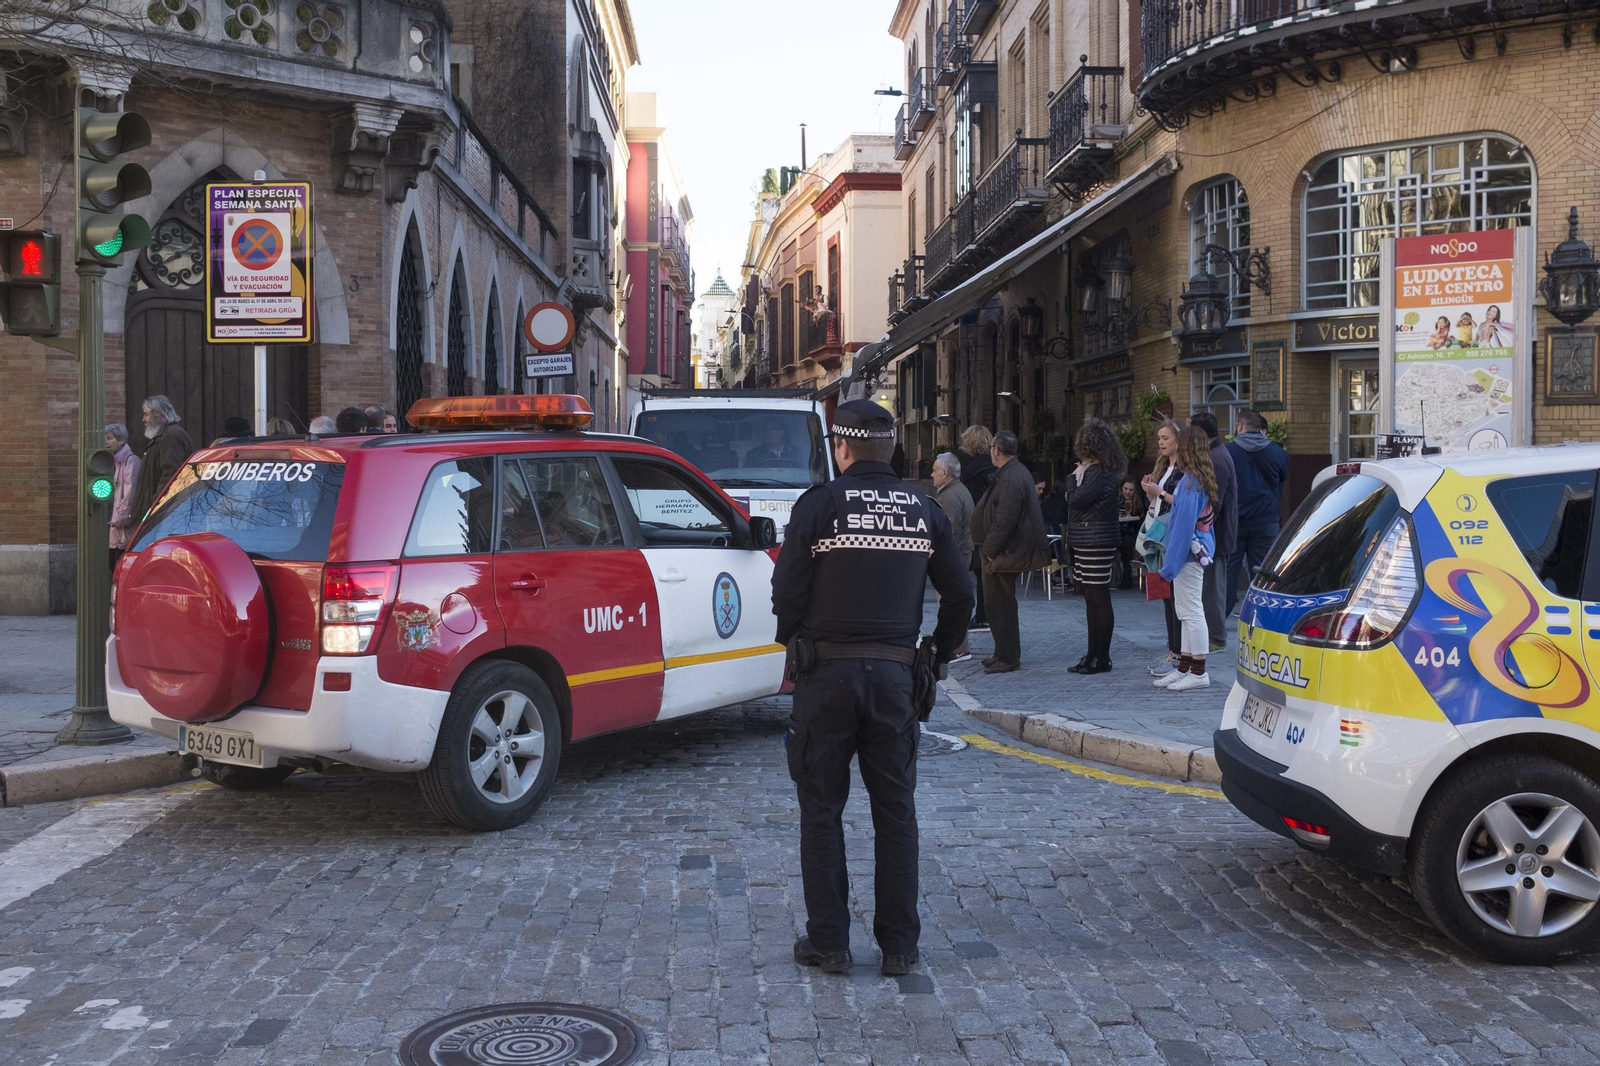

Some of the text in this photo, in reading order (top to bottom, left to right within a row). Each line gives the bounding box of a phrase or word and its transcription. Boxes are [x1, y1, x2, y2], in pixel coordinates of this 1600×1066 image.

[215, 189, 302, 198] PLAN ESPECIAL
[214, 200, 302, 209] SEMANA SANTA
[1403, 264, 1504, 285] LUDOTECA
[1403, 280, 1504, 297] EN EL CENTRO
[1430, 294, 1474, 305] BILINGÜE
[1317, 322, 1379, 340] Victor
[550, 356, 572, 364] GARAJES
[533, 365, 567, 373] AUTORIZADOS
[201, 462, 317, 482] BOMBEROS
[845, 489, 922, 506] POLICIA
[866, 504, 907, 515] LOCAL
[847, 513, 928, 532] SEVILLA
[1450, 520, 1489, 530] 092
[1458, 535, 1483, 545] 112
[1414, 647, 1461, 667] 404
[1251, 646, 1311, 689] LOCAL
[187, 730, 255, 760] 6349 GXT
